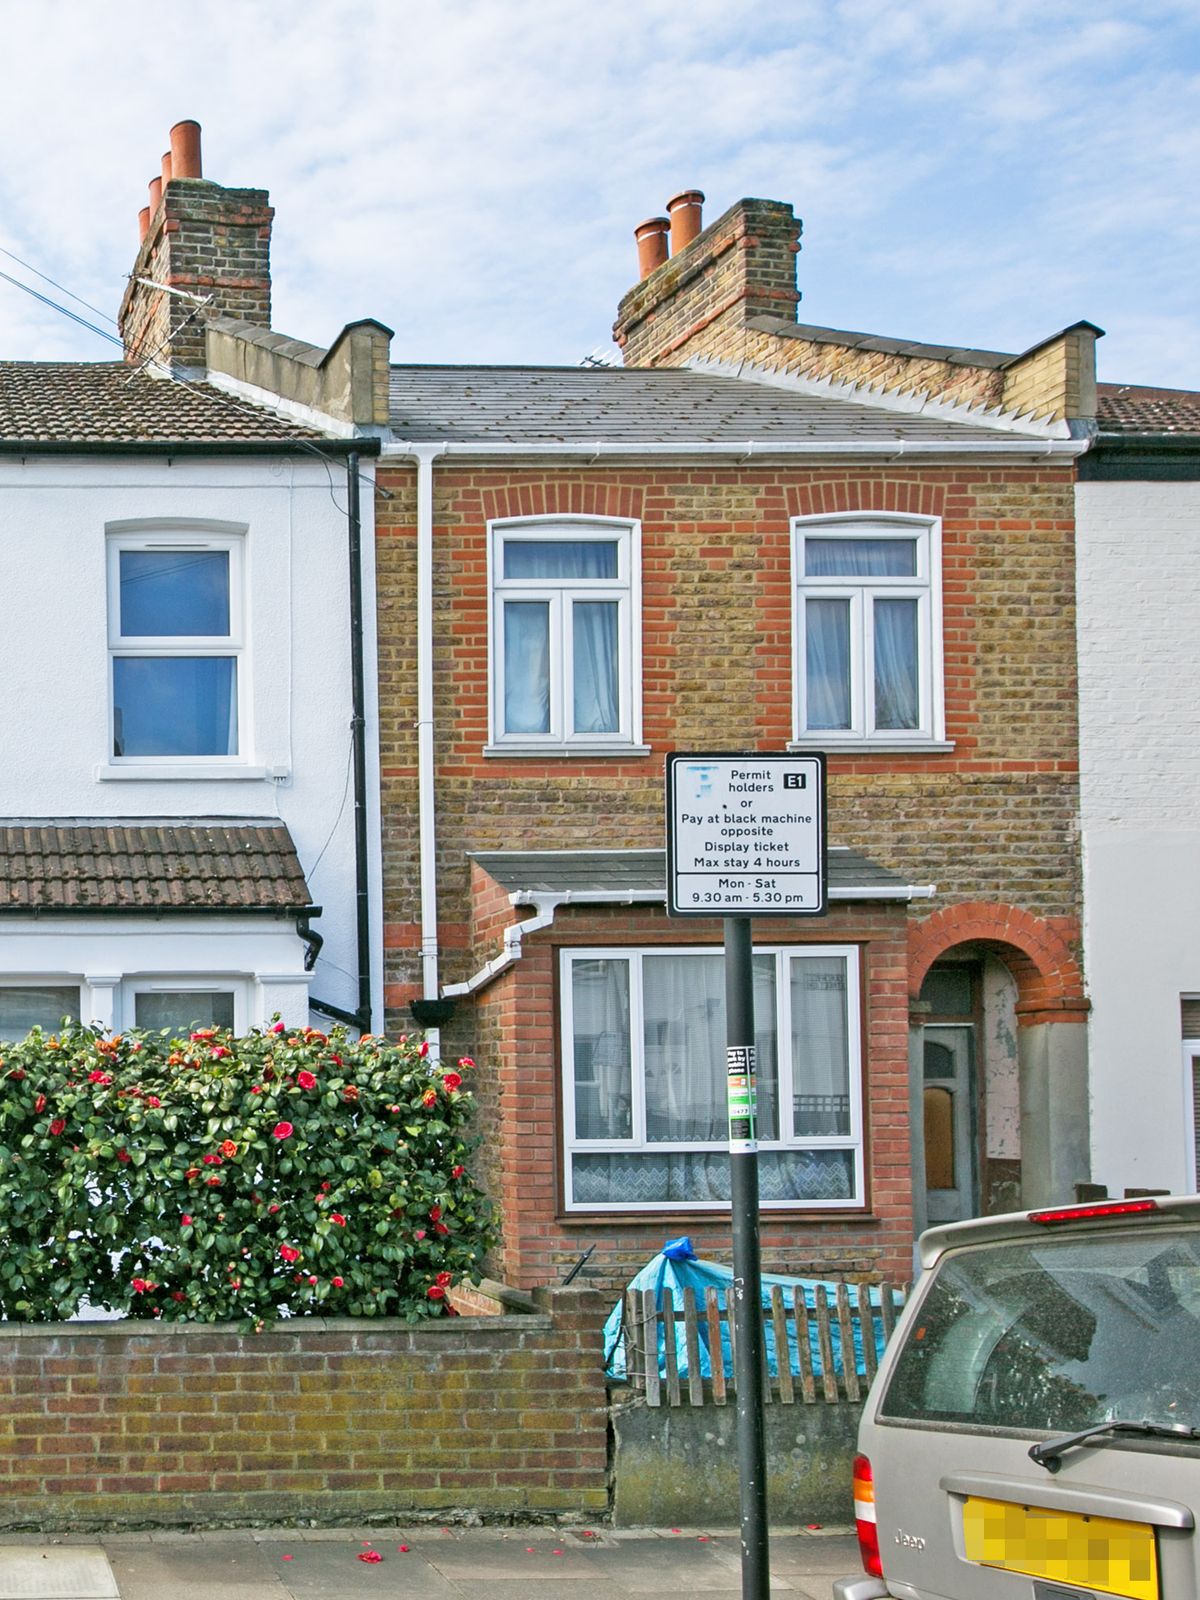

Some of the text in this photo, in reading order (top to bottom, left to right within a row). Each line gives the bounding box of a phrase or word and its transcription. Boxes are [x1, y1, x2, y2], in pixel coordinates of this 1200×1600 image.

[731, 769, 772, 780] Permit
[787, 774, 803, 788] E1
[728, 782, 774, 793] holders
[740, 800, 753, 808] or
[681, 813, 812, 826] Pay at black machine
[720, 826, 774, 838] opposite
[704, 841, 789, 854] Display ticket
[694, 857, 801, 870] Max stay 4 hours
[718, 878, 745, 889] Mon
[755, 878, 777, 889] Sat
[692, 892, 722, 903] 9.30
[724, 894, 743, 903] am
[752, 892, 782, 903] 5.30
[784, 894, 804, 904] pm
[894, 1528, 926, 1554] Jeep
